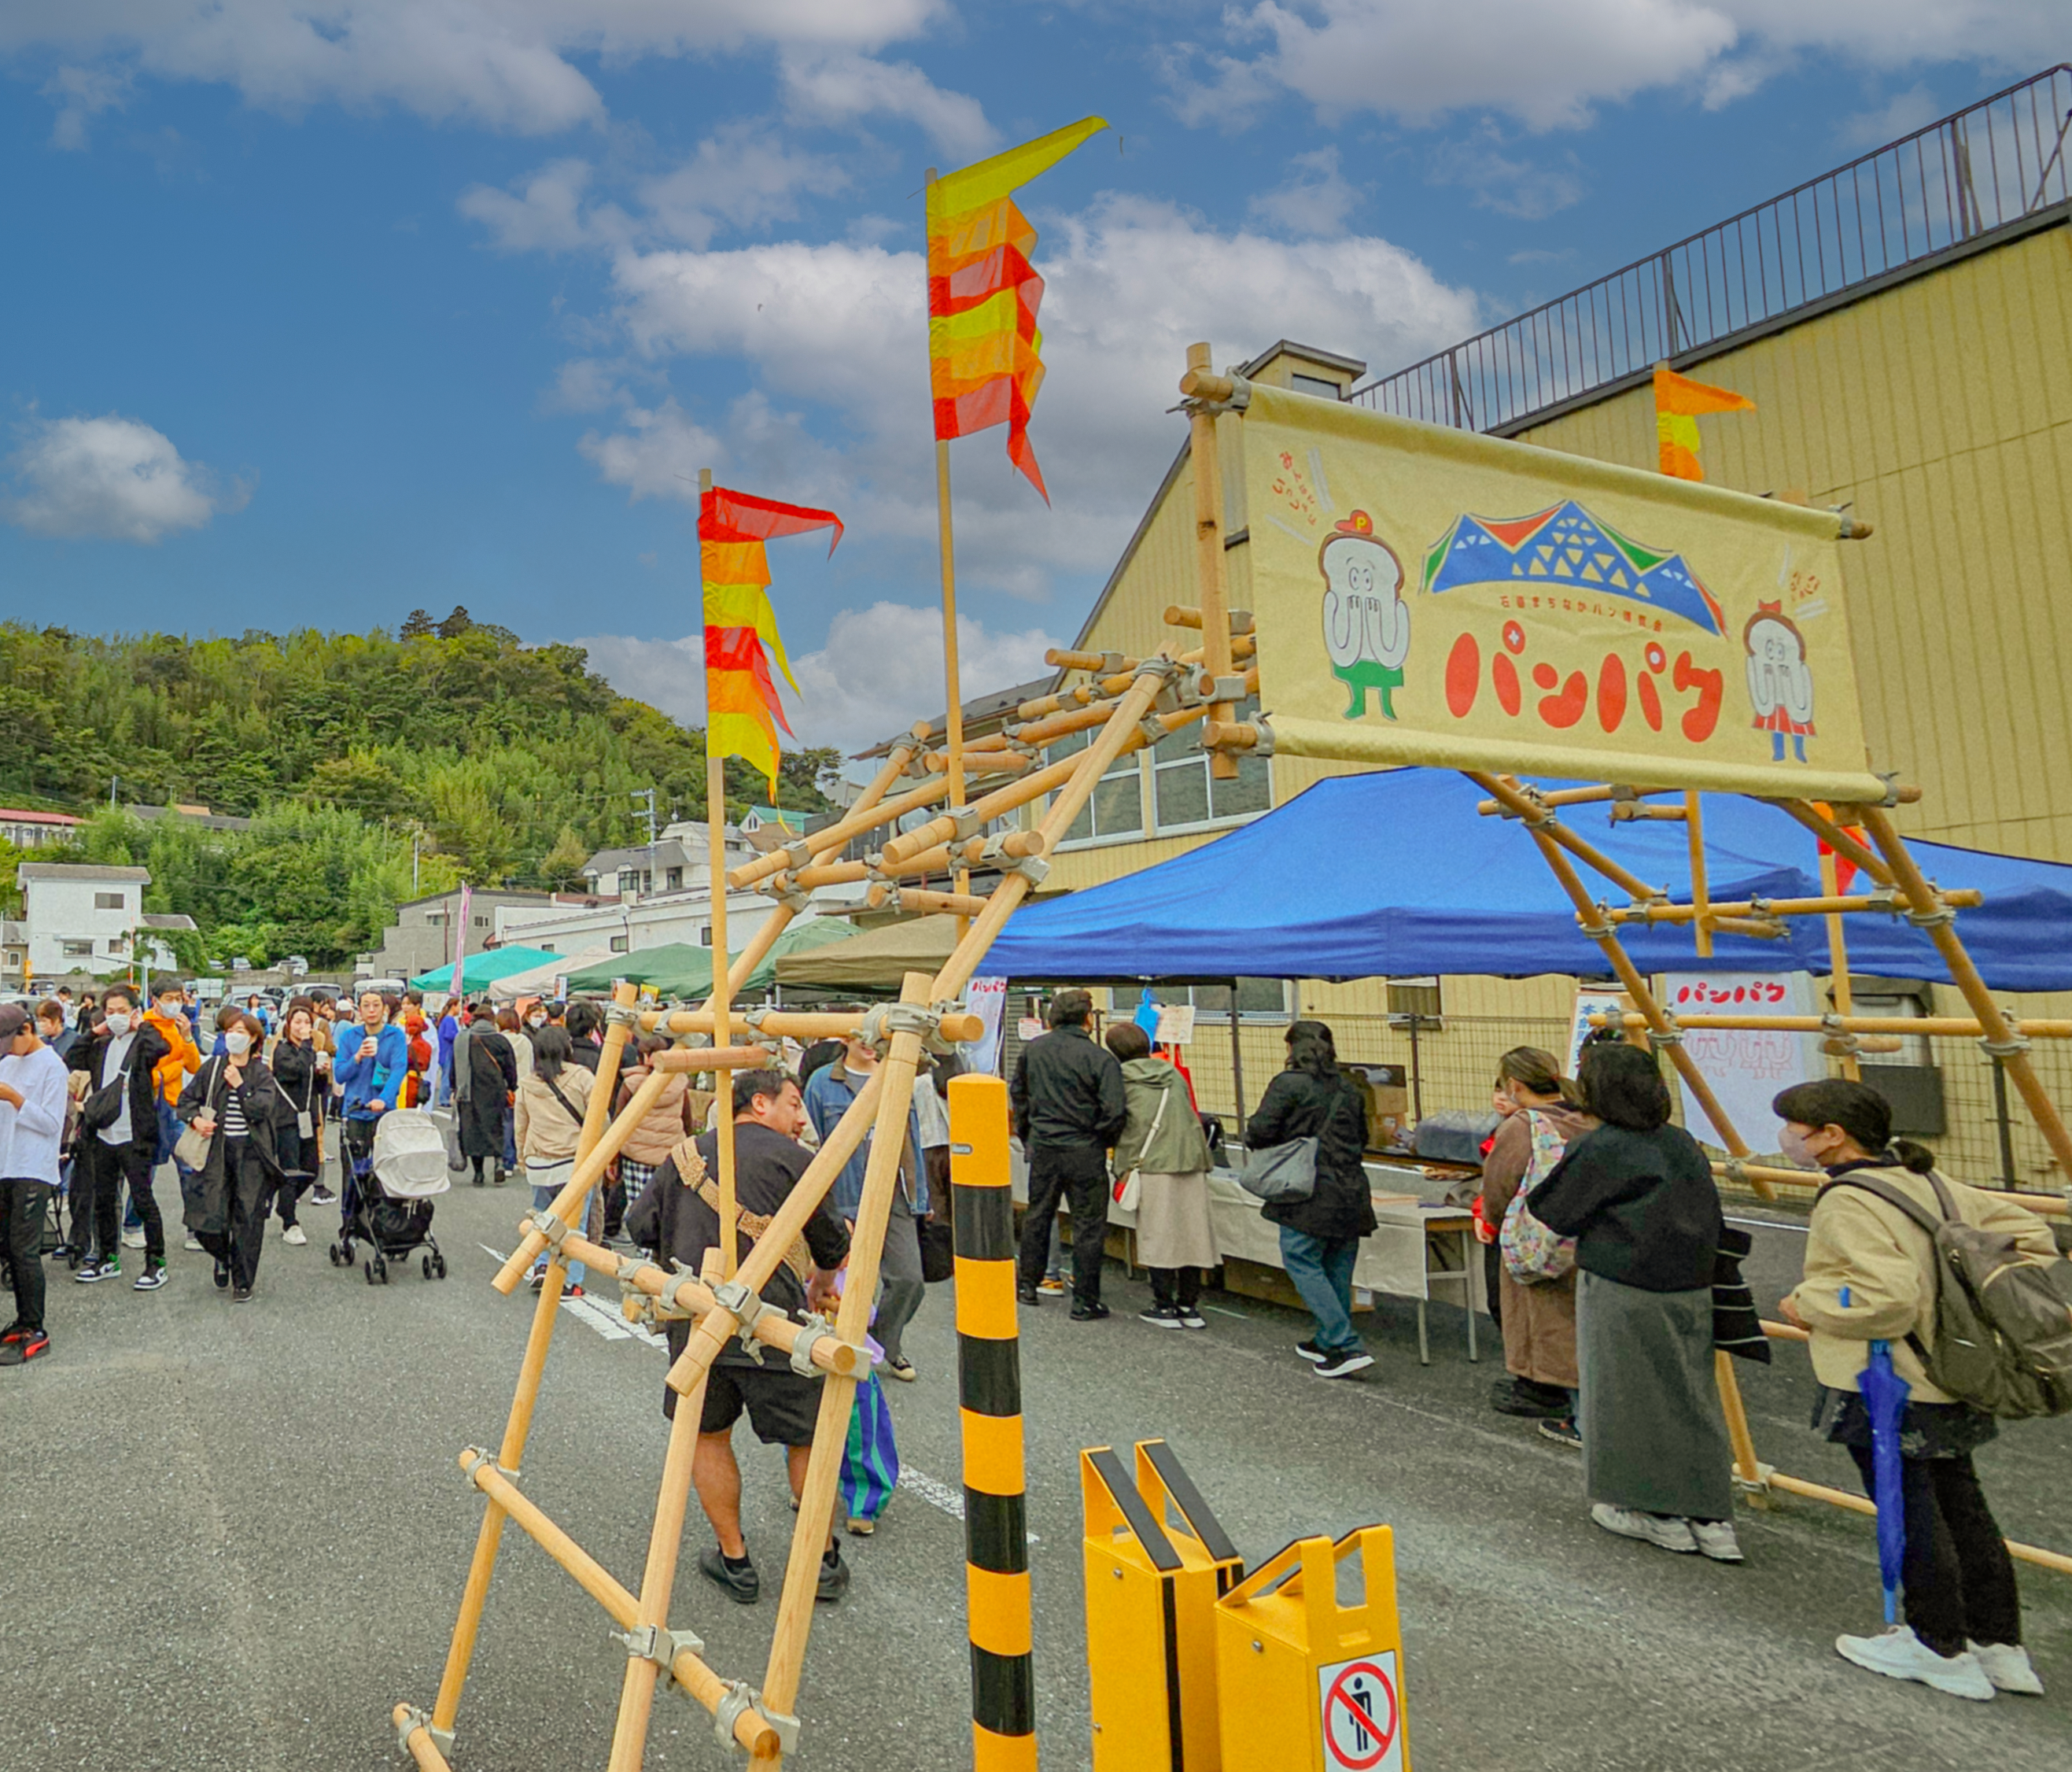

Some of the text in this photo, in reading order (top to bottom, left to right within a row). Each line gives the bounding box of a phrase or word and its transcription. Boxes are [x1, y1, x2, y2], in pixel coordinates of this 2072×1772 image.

[1356, 516, 1368, 530] P
[1445, 619, 1724, 743] パンパク
[1677, 981, 1786, 1004] パンパク
